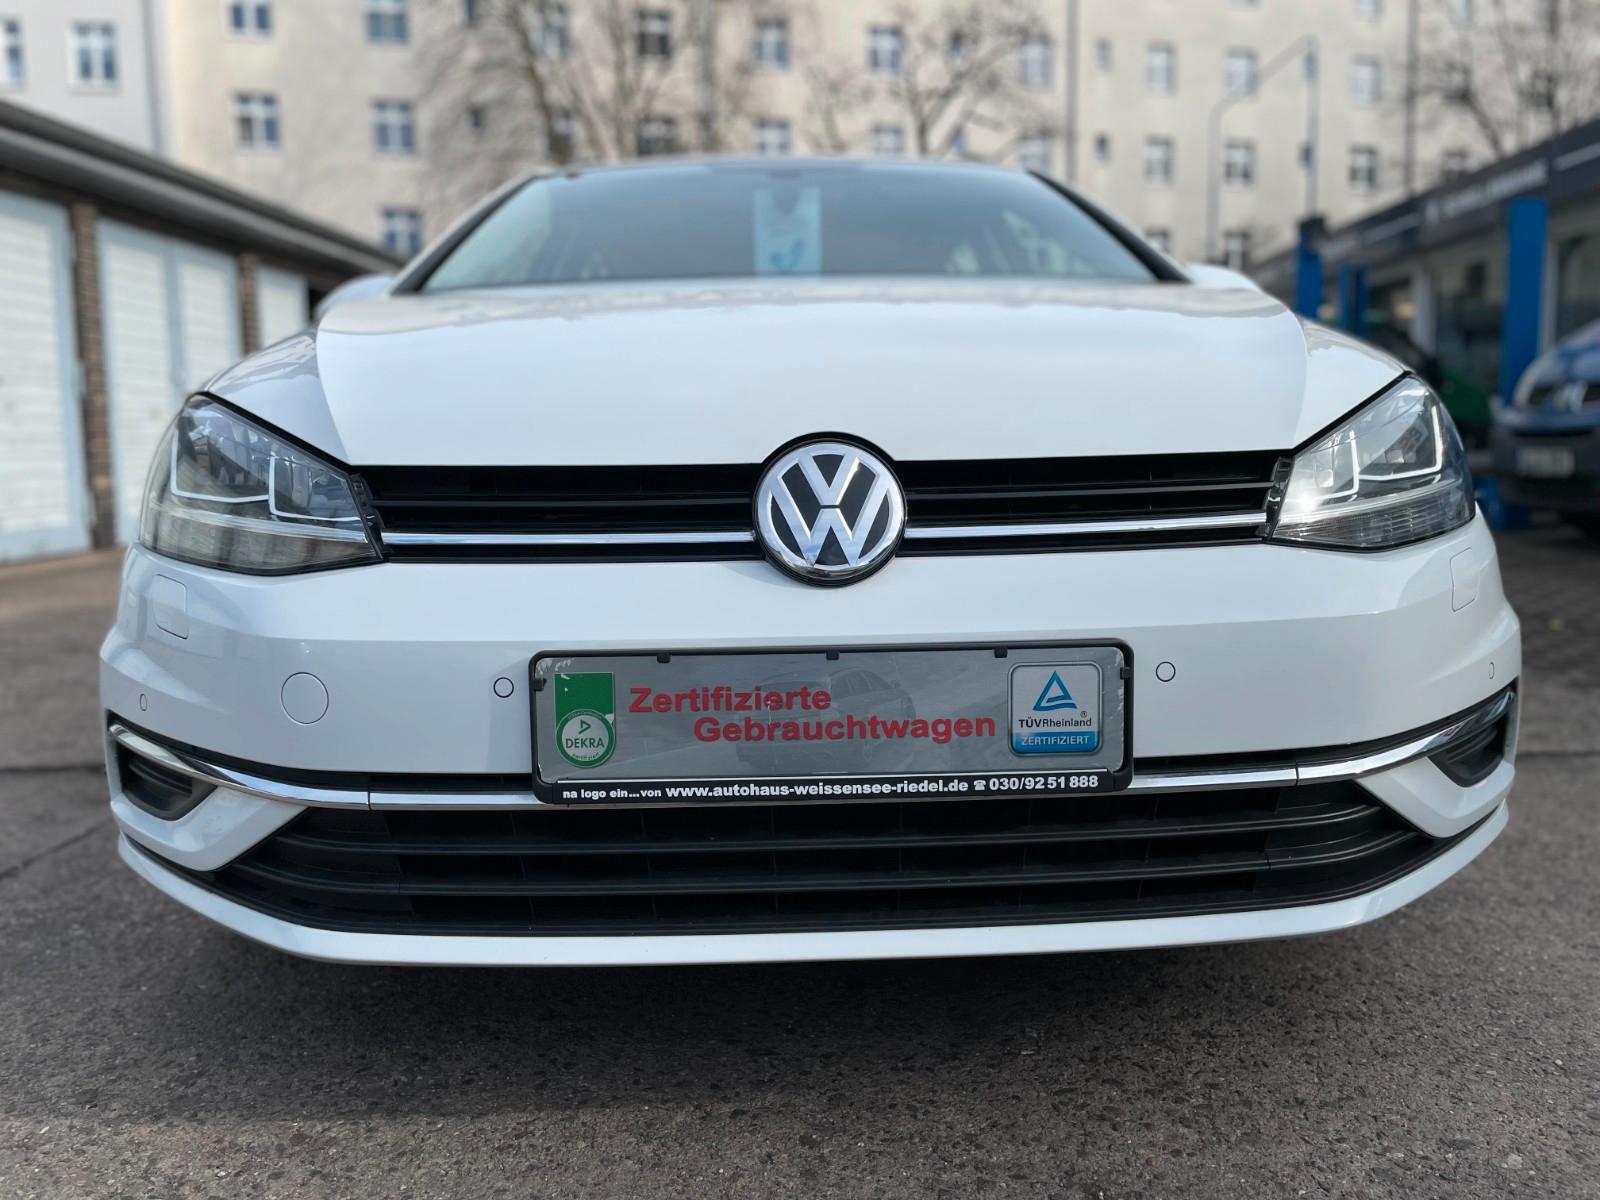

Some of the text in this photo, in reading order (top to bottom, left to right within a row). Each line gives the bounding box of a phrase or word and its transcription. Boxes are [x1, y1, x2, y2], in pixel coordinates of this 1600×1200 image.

[757, 442, 903, 572] VW
[629, 686, 832, 713] Zertifizierte
[694, 715, 995, 744] Gebrauchtwagen
[1021, 735, 1090, 746] ZERTIFIZIERT
[565, 737, 605, 749] DEKRA
[563, 790, 578, 798] na
[581, 789, 607, 800] logo
[665, 779, 969, 798] www.autohaus-weissensee-riedel.de
